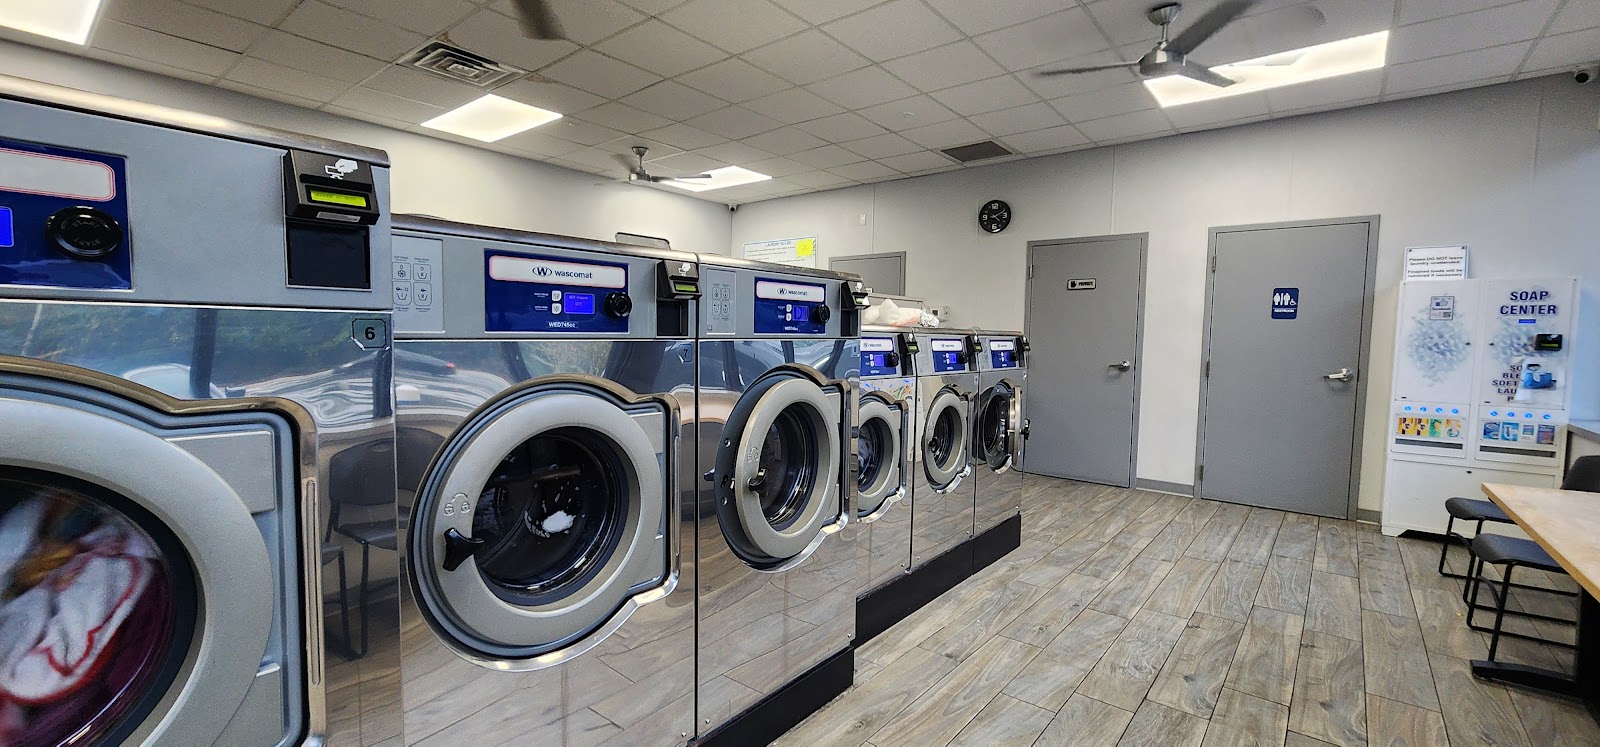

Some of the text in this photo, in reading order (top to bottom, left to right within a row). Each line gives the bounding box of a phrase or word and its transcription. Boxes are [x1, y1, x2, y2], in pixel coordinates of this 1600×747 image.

[554, 269, 593, 279] wascomat
[1510, 290, 1549, 301] SOAP
[1500, 304, 1557, 315] CENTER
[365, 326, 376, 341] 6
[683, 349, 689, 357] 7
